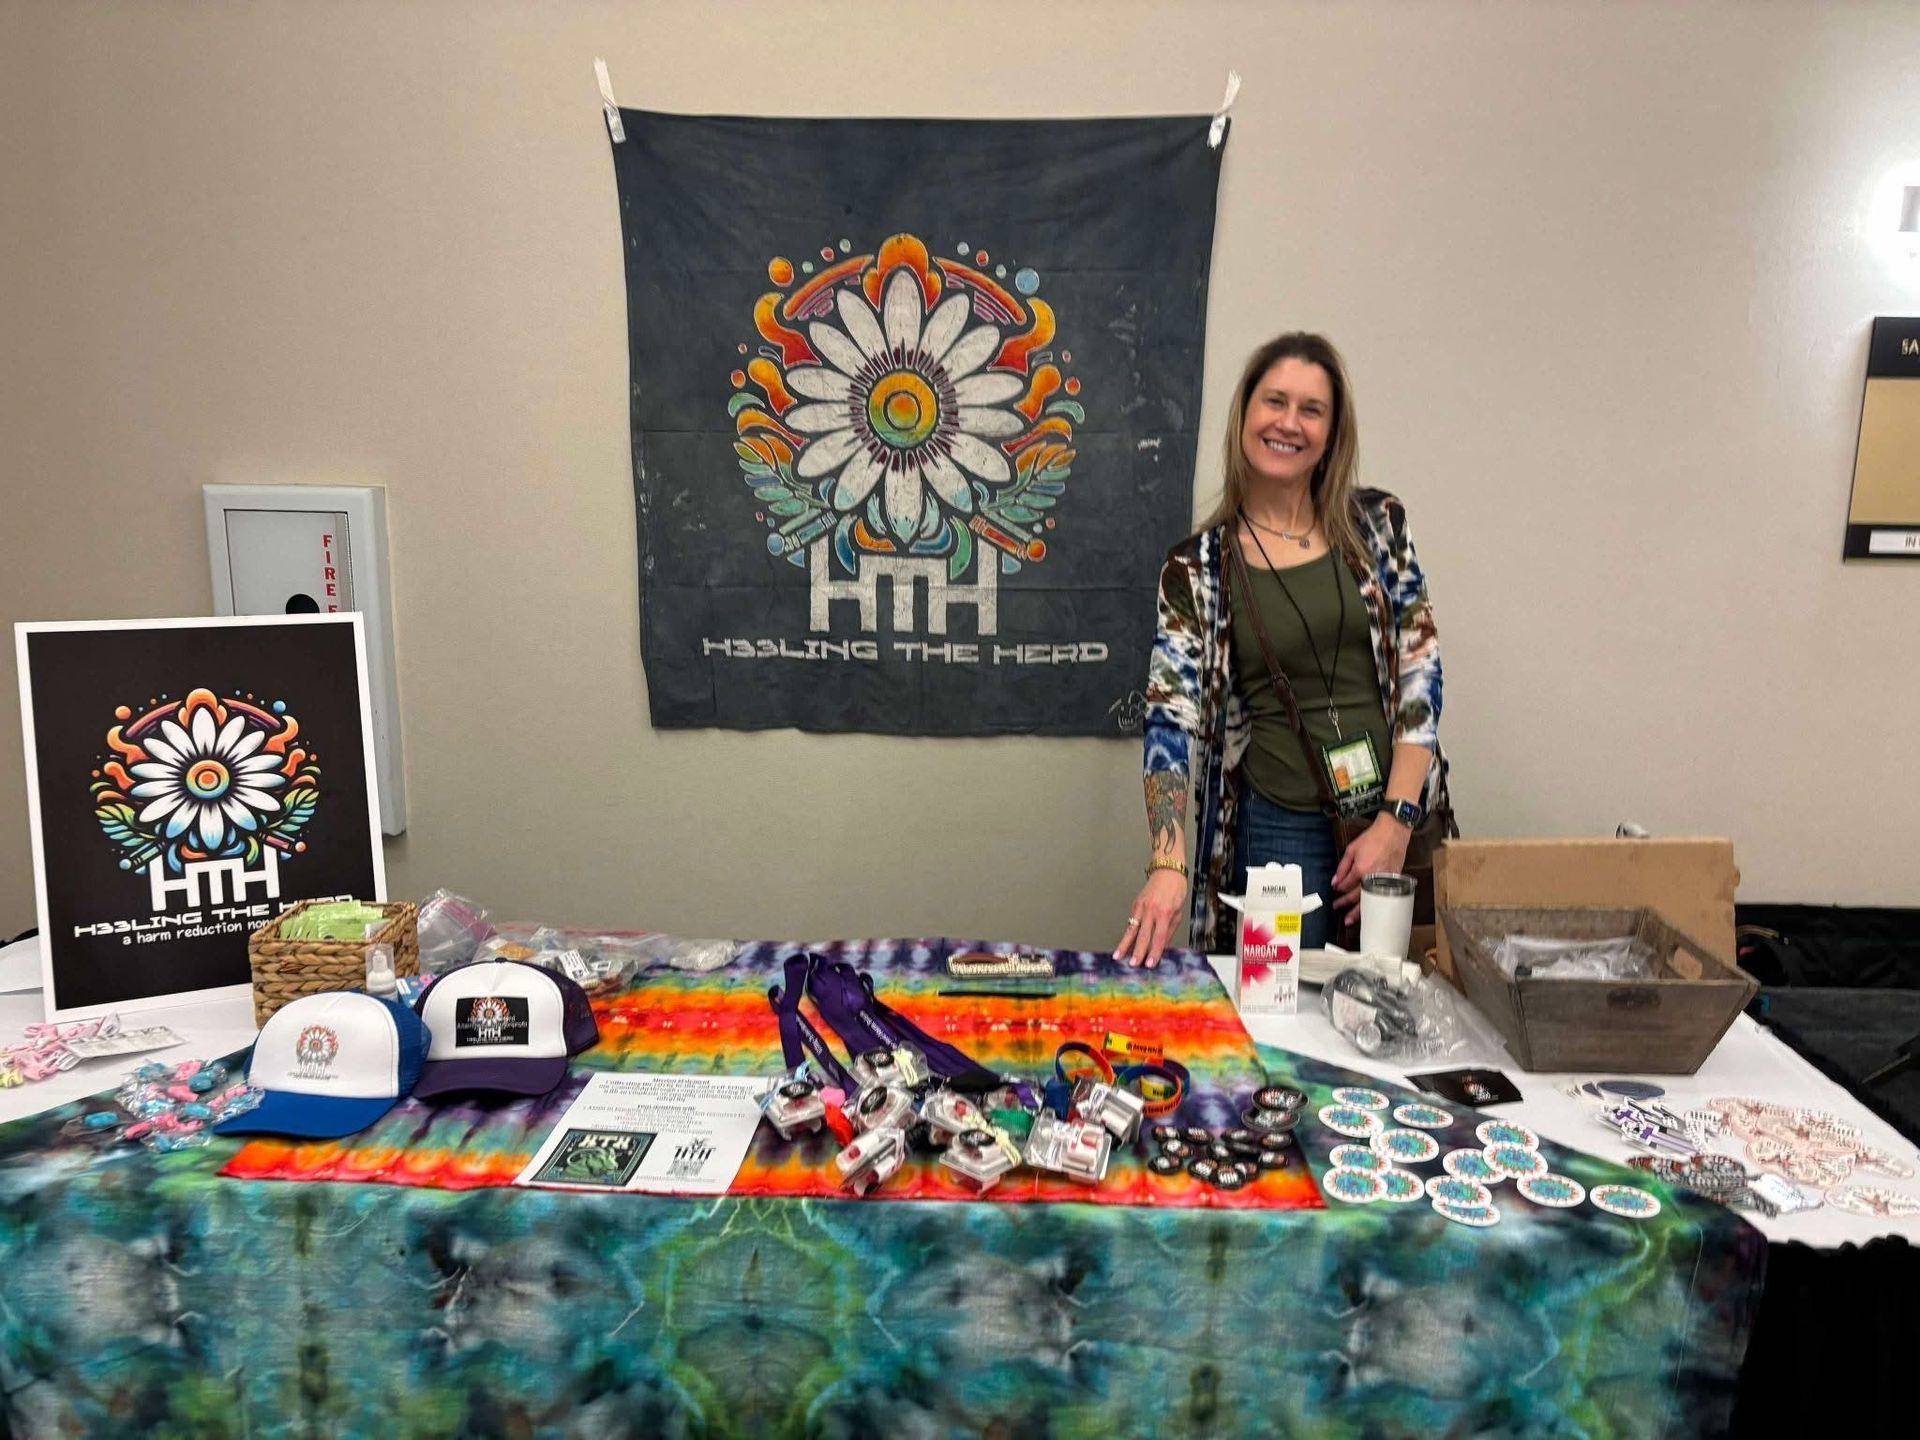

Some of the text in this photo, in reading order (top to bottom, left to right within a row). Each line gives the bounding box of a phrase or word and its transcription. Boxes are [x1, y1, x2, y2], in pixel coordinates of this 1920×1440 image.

[323, 534, 337, 597] FIRE
[810, 535, 997, 636] HTH
[702, 637, 1109, 665] H33LING THE HERD
[150, 845, 280, 912] HTH
[74, 911, 202, 938] H33LING
[211, 903, 270, 921] THE
[122, 935, 132, 946] a
[136, 930, 172, 945] harm
[176, 921, 243, 939] reduction
[1243, 943, 1278, 959] NARCAN
[577, 1134, 632, 1149] HTH
